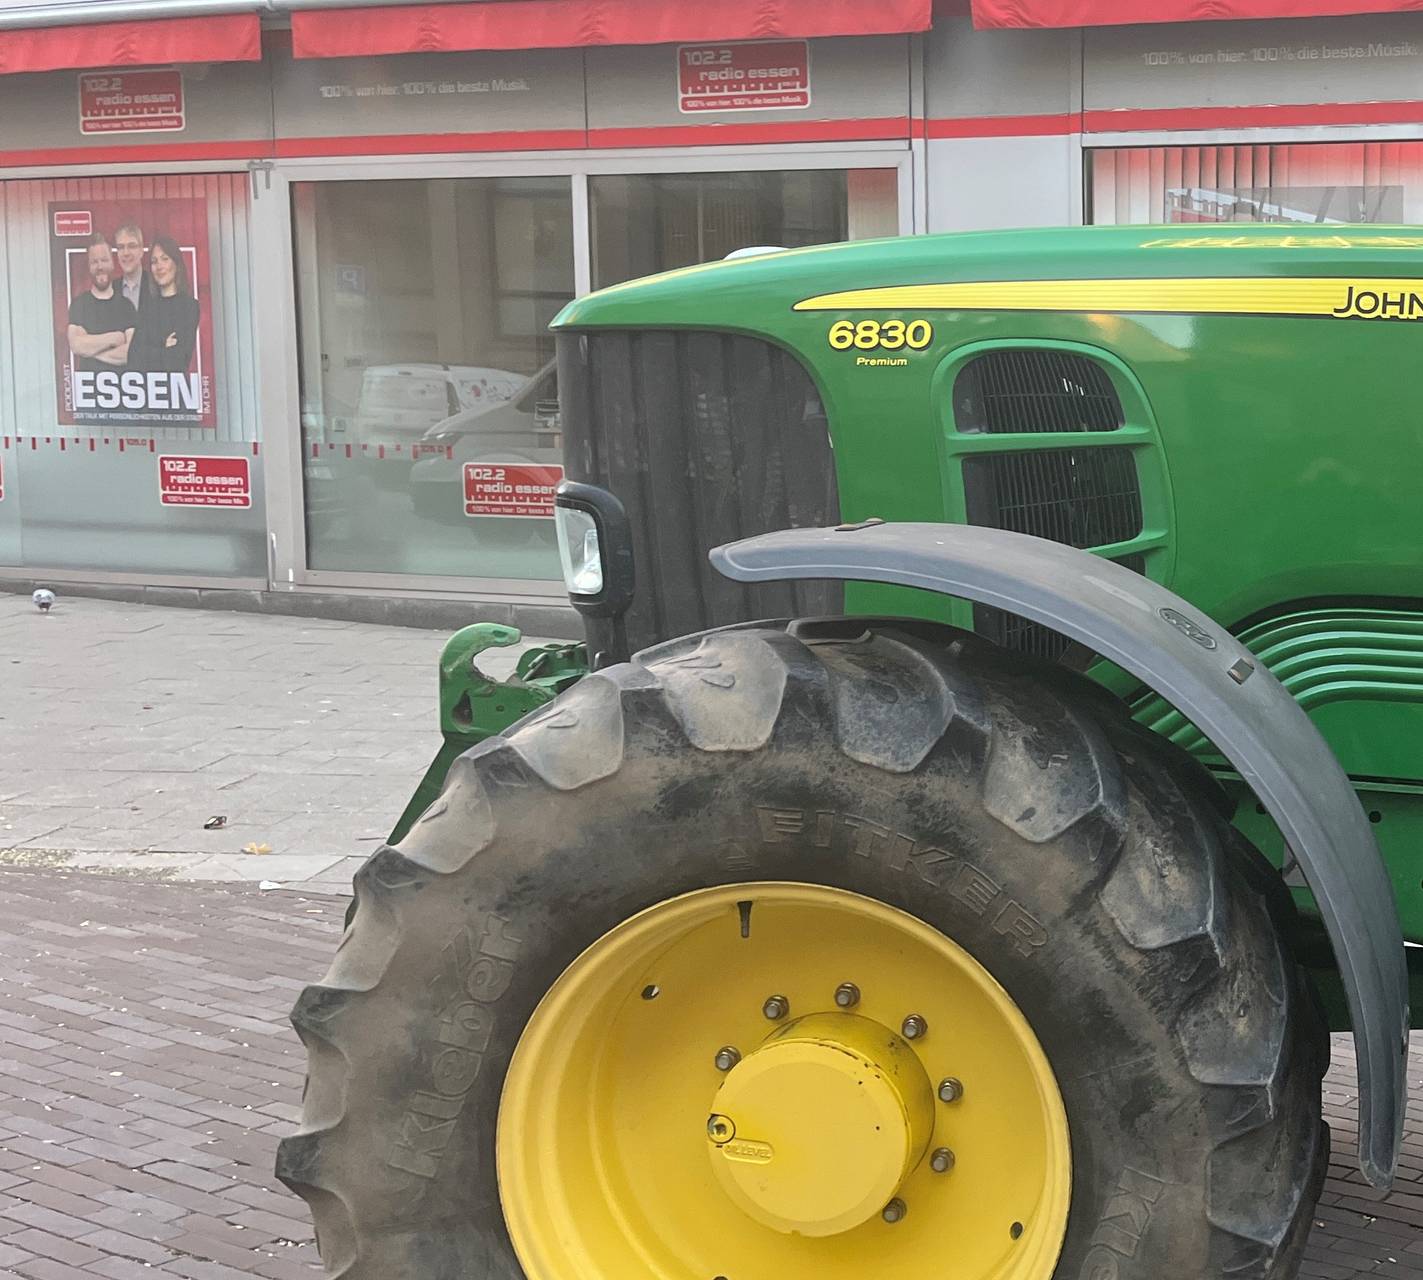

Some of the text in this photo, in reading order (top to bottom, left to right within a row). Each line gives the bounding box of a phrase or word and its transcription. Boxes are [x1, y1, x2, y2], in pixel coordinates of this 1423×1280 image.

[684, 50, 732, 65] 102.2
[1188, 54, 1213, 64] von
[1297, 47, 1319, 60] die
[1322, 45, 1366, 59] beste
[699, 67, 800, 81] radio essen
[96, 93, 176, 105] radio essen
[828, 319, 934, 351] 6830
[856, 357, 908, 366] Premium
[74, 371, 199, 409] ESSEN
[163, 460, 197, 472] 102.2
[169, 474, 244, 485] radio essen
[468, 468, 505, 481] 102.2
[476, 482, 512, 493] radio
[387, 910, 523, 1179] Kleber
